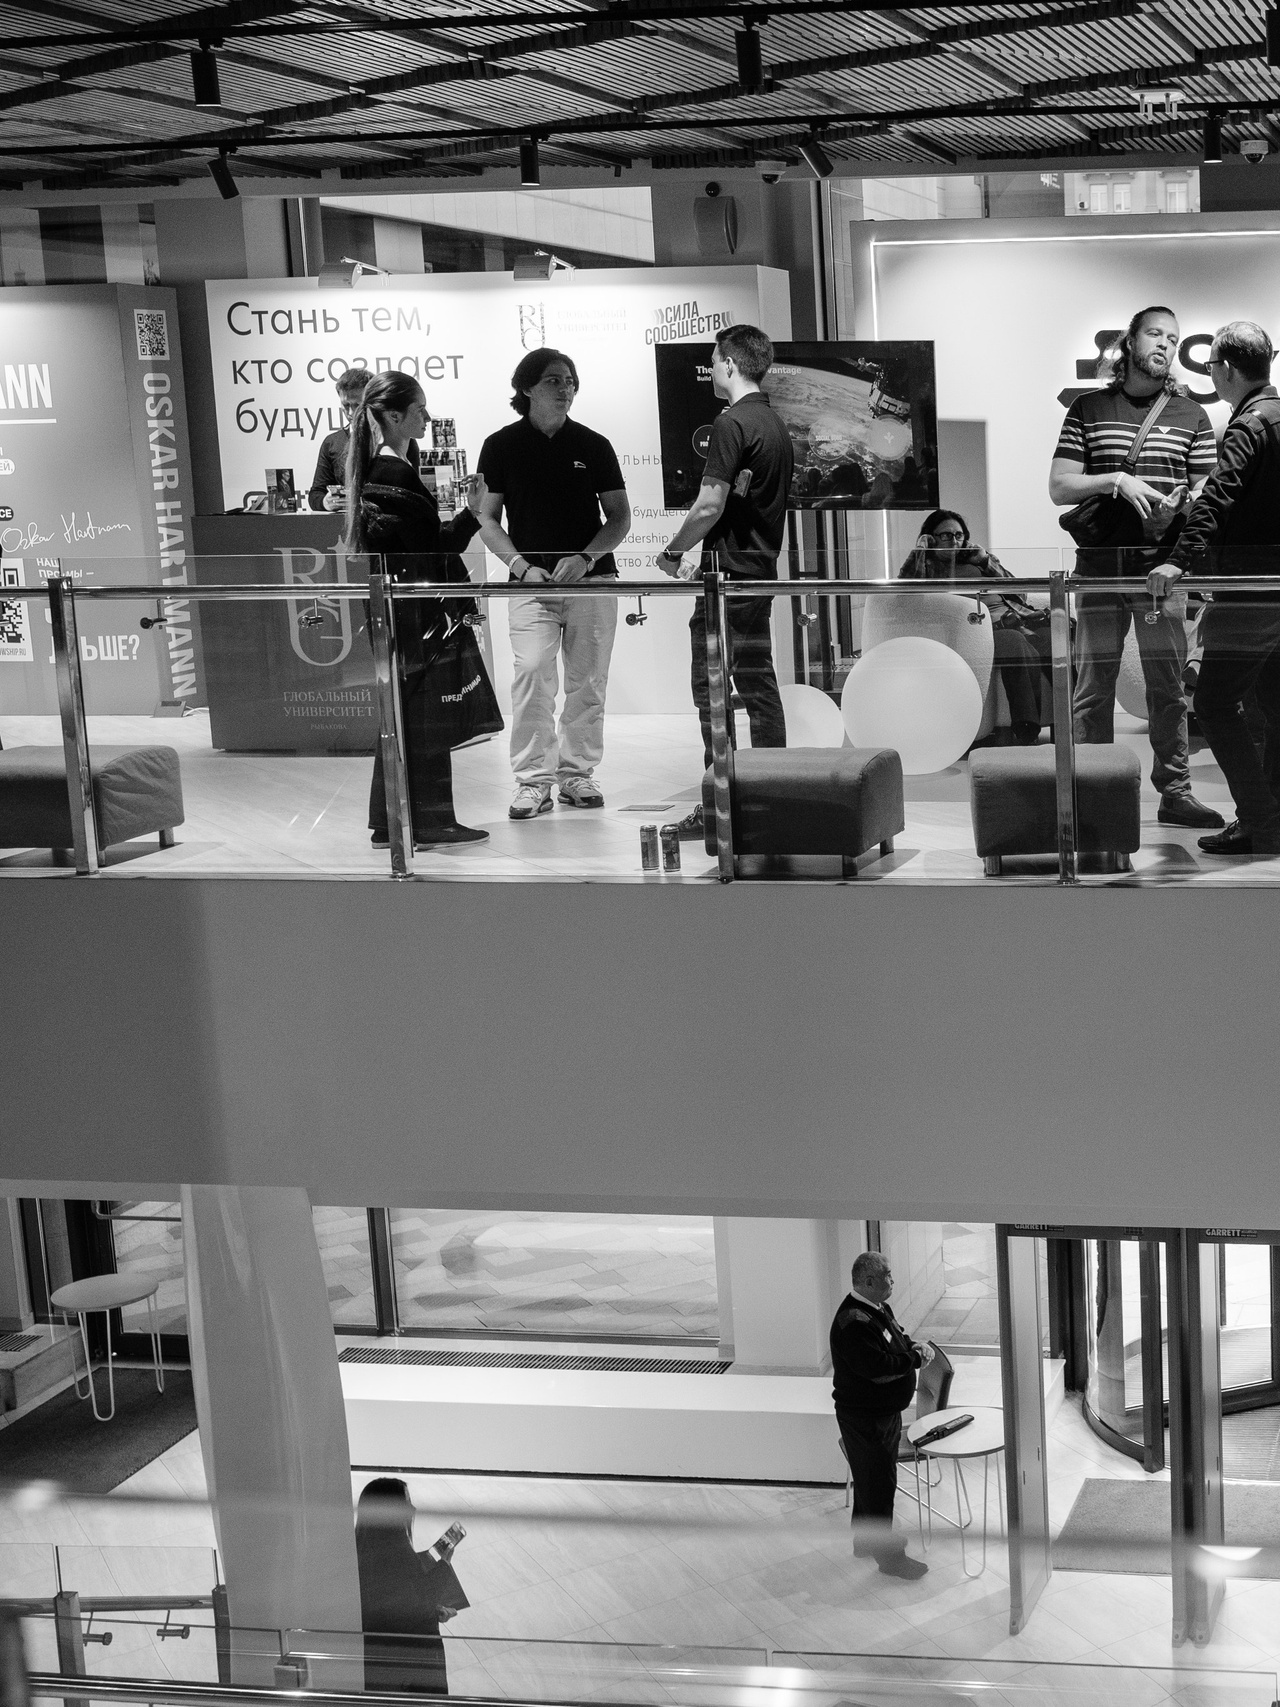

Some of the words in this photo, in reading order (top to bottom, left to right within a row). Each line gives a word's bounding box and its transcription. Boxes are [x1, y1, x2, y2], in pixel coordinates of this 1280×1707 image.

[227, 301, 340, 335] Стань
[352, 306, 431, 336] тем,
[665, 301, 699, 324] СИЛА
[645, 312, 721, 346] СООБЩЕСТВ
[232, 359, 293, 385] кто
[695, 366, 713, 374] The
[0, 364, 52, 409] NN
[143, 373, 179, 491] OSKAR
[283, 689, 371, 702] ГЛОБАЛЬНЫЙ
[283, 706, 374, 717] УНИВЕРСИТЕТ
[1205, 1228, 1241, 1237] GARRETT
